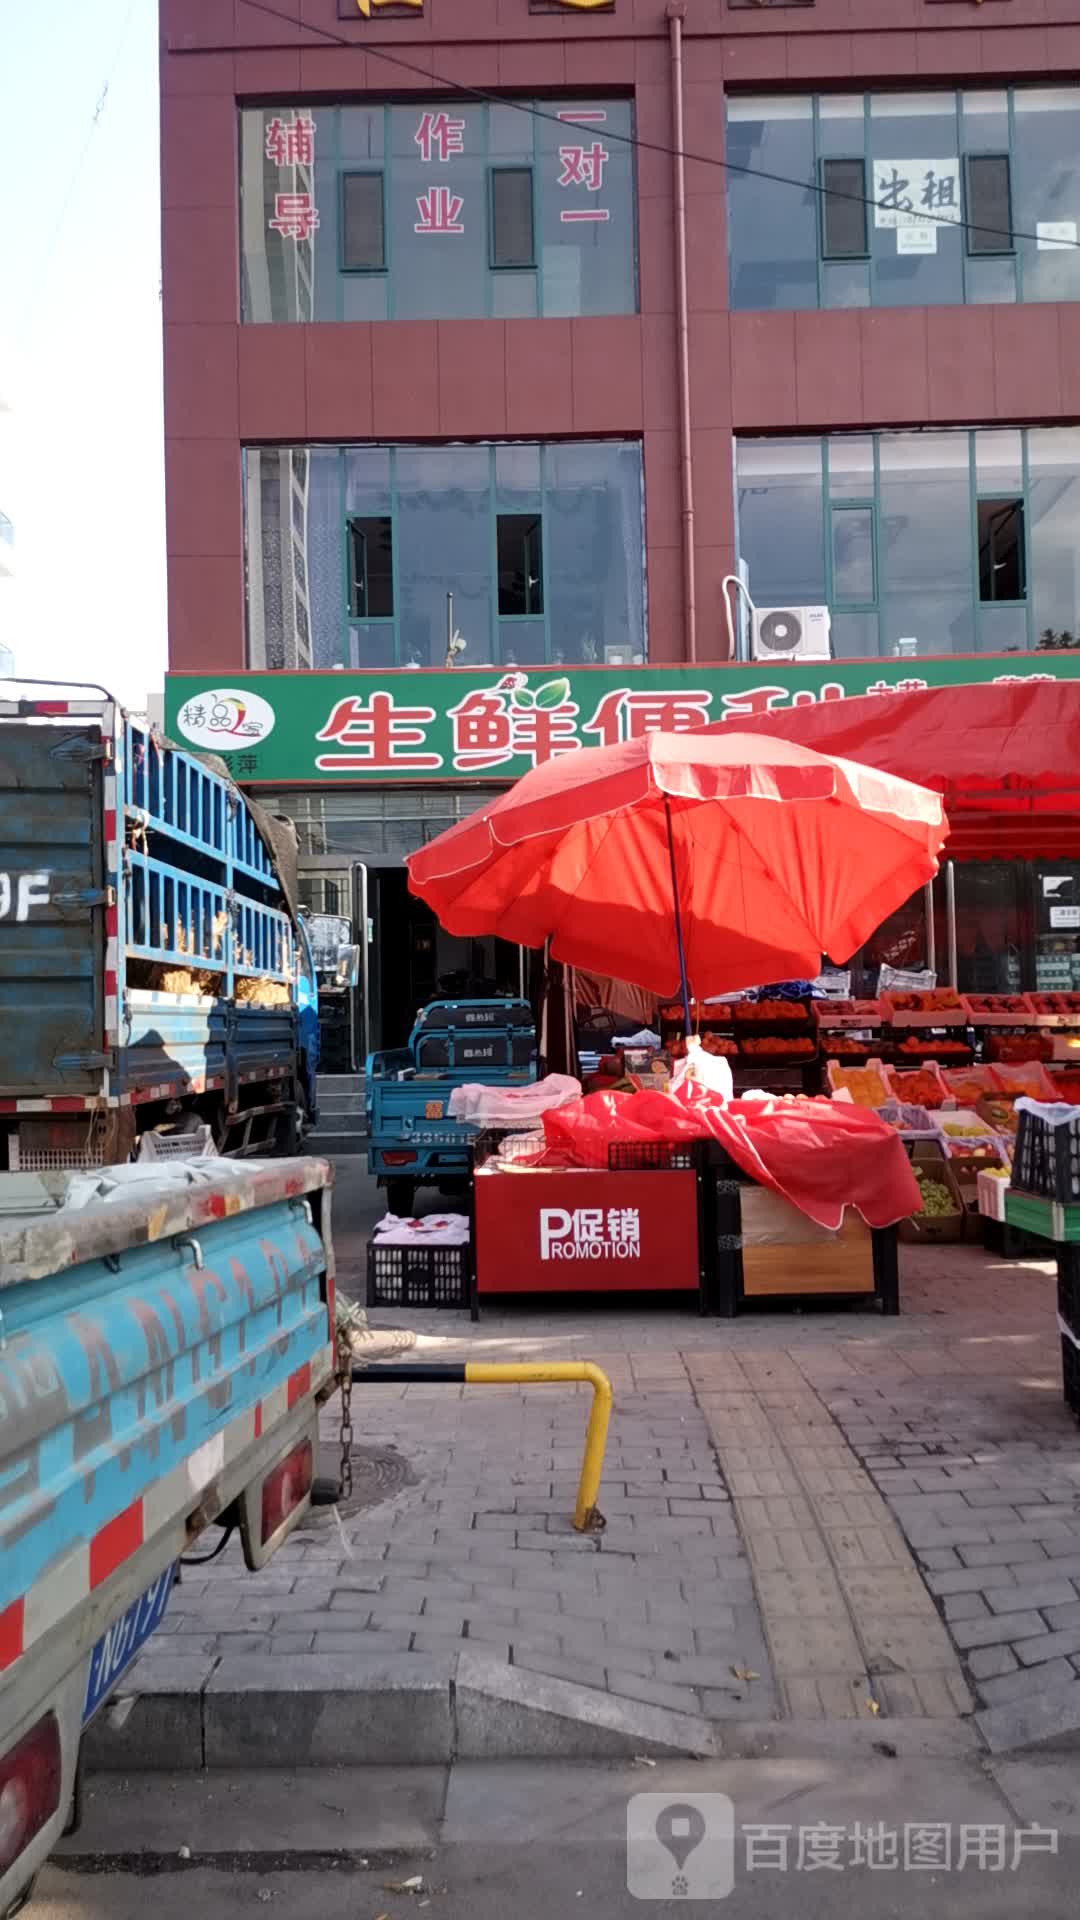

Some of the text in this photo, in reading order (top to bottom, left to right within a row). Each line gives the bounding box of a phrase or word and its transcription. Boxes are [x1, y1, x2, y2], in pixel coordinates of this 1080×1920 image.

[265, 117, 320, 241] 辅导
[414, 111, 465, 234] 作业
[879, 167, 958, 210] 出租
